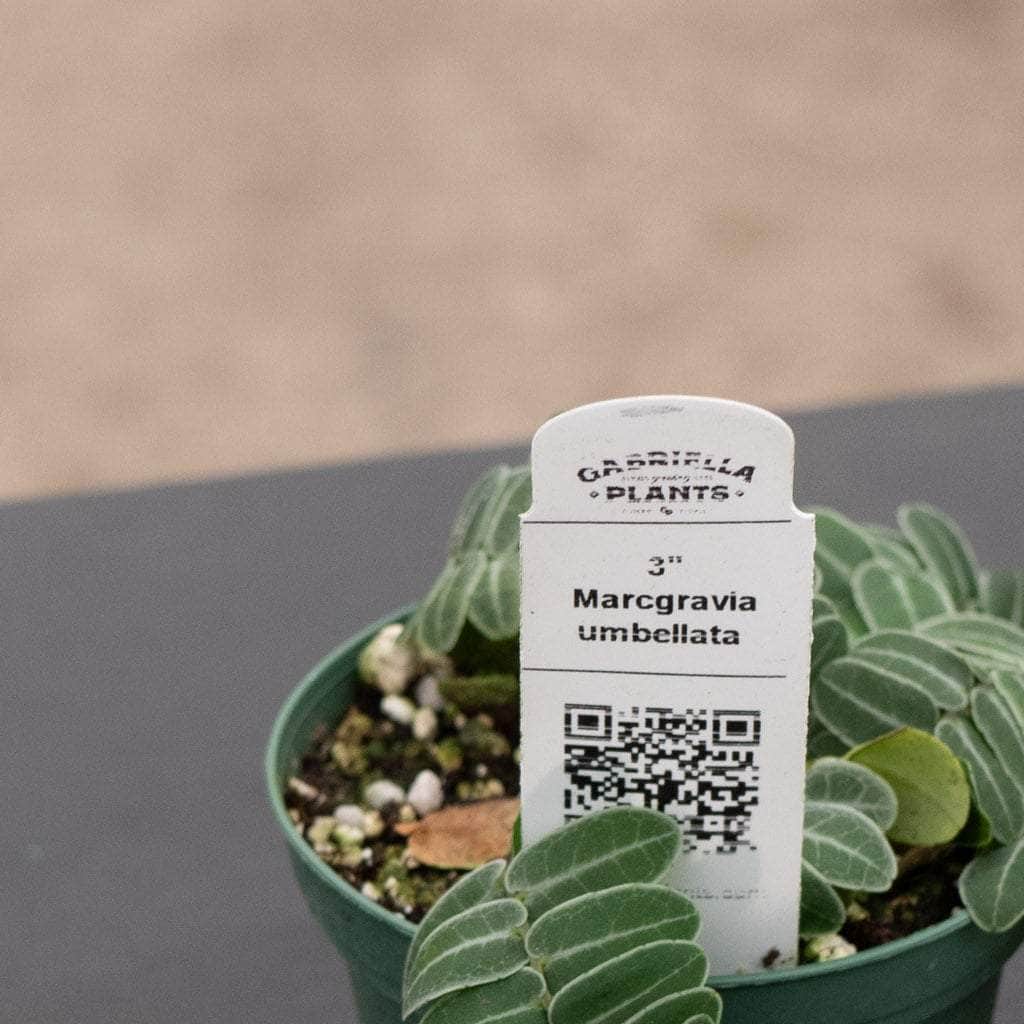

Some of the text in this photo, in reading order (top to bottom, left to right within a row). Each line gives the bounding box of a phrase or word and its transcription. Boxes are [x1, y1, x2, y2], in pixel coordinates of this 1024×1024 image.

[606, 485, 730, 502] PLANTS
[648, 555, 683, 576] 3"
[573, 588, 757, 615] Marcgravia
[578, 622, 740, 645] umbellata
